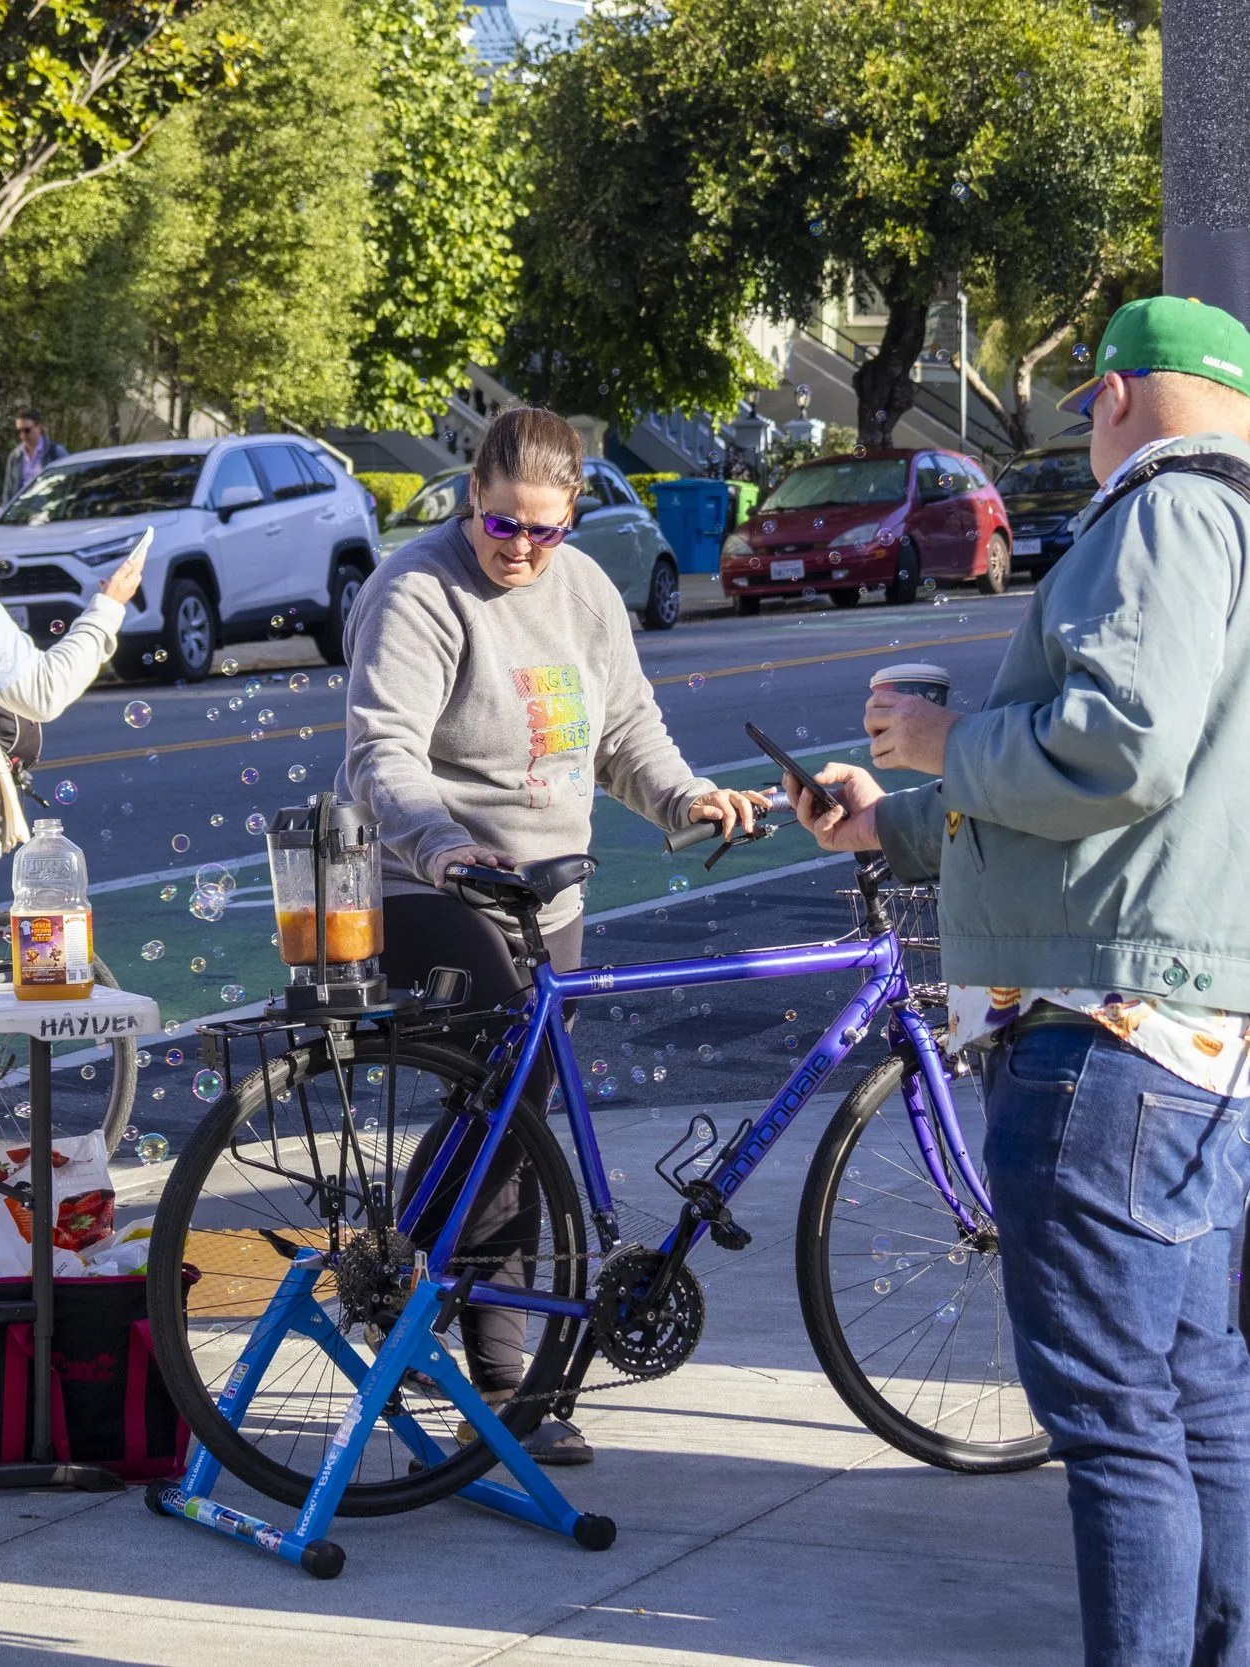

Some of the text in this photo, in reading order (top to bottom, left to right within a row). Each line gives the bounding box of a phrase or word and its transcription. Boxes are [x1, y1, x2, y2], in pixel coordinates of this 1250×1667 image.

[520, 670, 572, 692] PAGE
[719, 1052, 832, 1200] annondale
[296, 1501, 317, 1537] ROCK
[318, 1448, 340, 1487] BIKE
